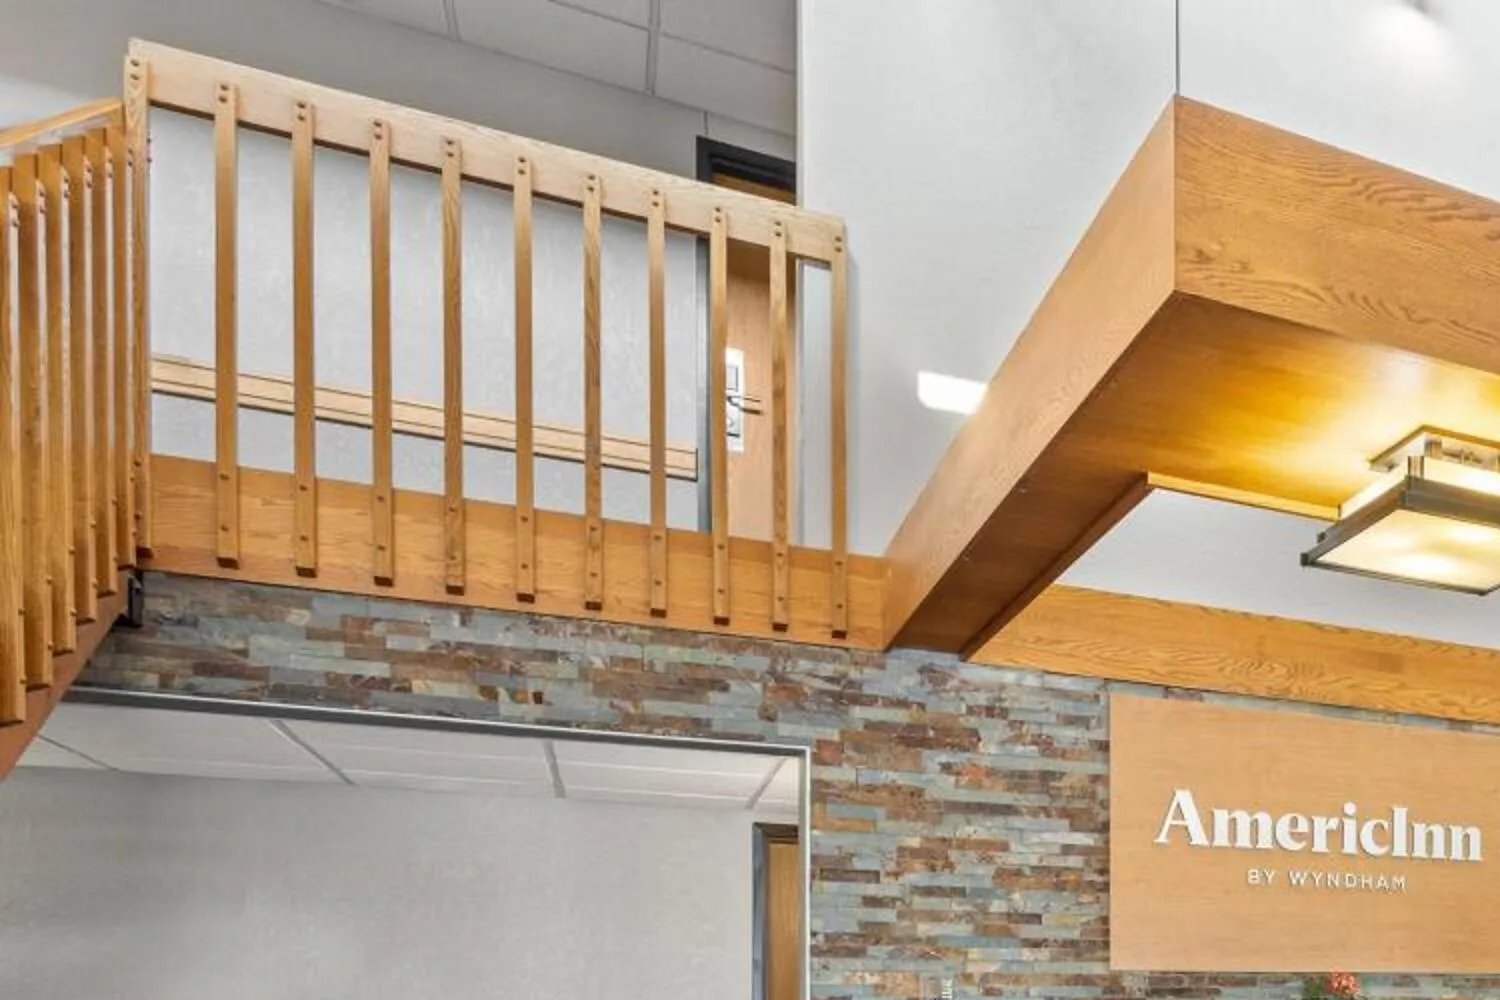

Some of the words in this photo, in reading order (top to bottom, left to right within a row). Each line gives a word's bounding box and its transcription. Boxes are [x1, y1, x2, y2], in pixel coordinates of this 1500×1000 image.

[1154, 789, 1483, 861] AmericInn
[1247, 868, 1275, 886] BY
[1288, 870, 1406, 890] WYNDHAM
